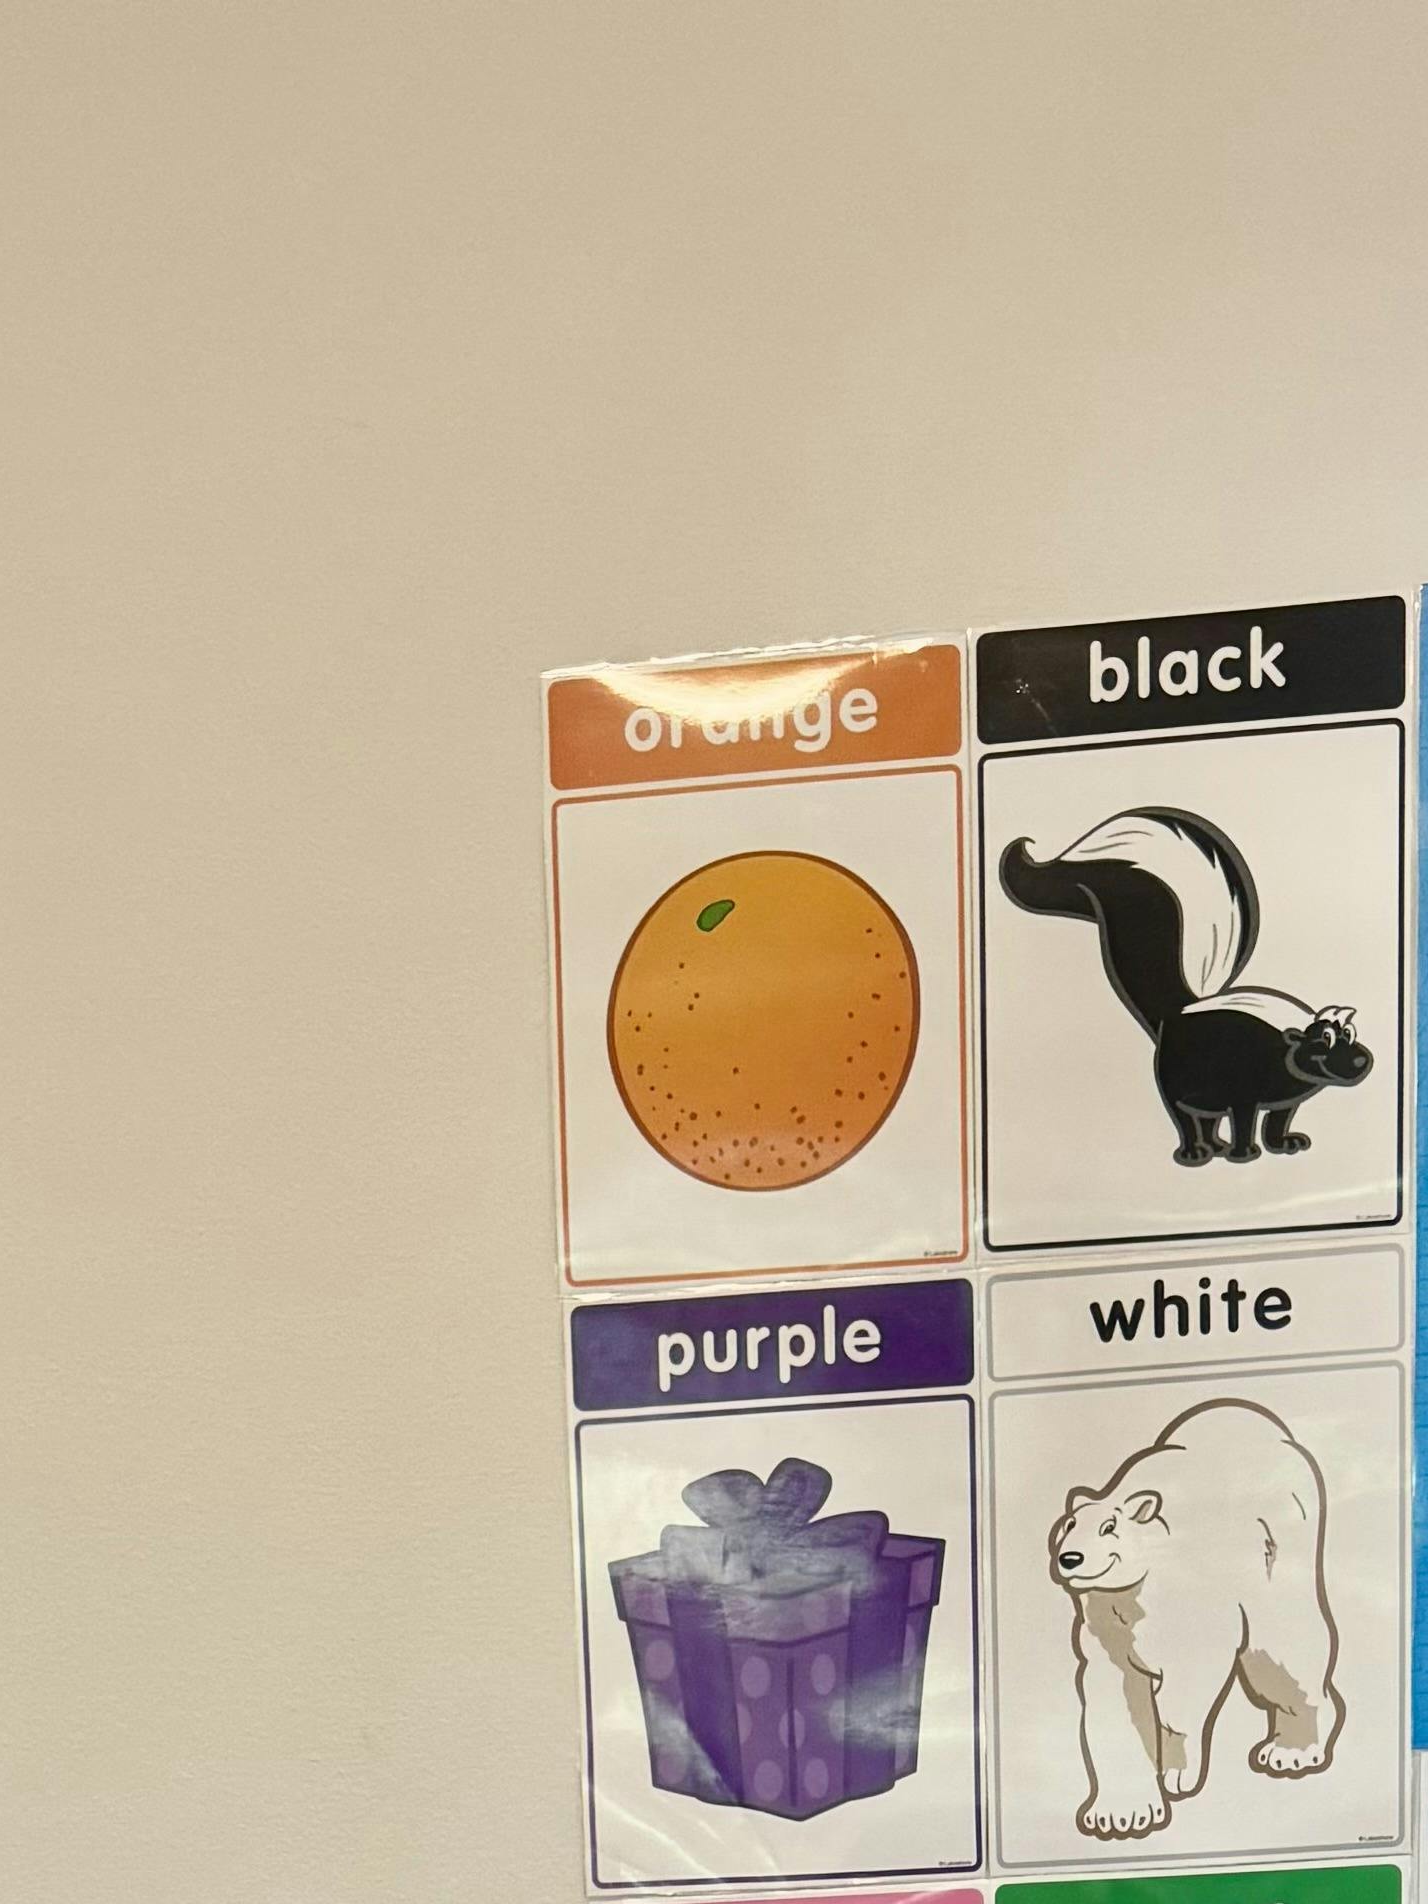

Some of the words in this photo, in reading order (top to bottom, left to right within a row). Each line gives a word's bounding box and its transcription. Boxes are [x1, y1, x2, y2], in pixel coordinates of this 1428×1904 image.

[1088, 626, 1286, 703] black
[658, 1305, 882, 1393] purple
[1090, 1278, 1293, 1344] white
